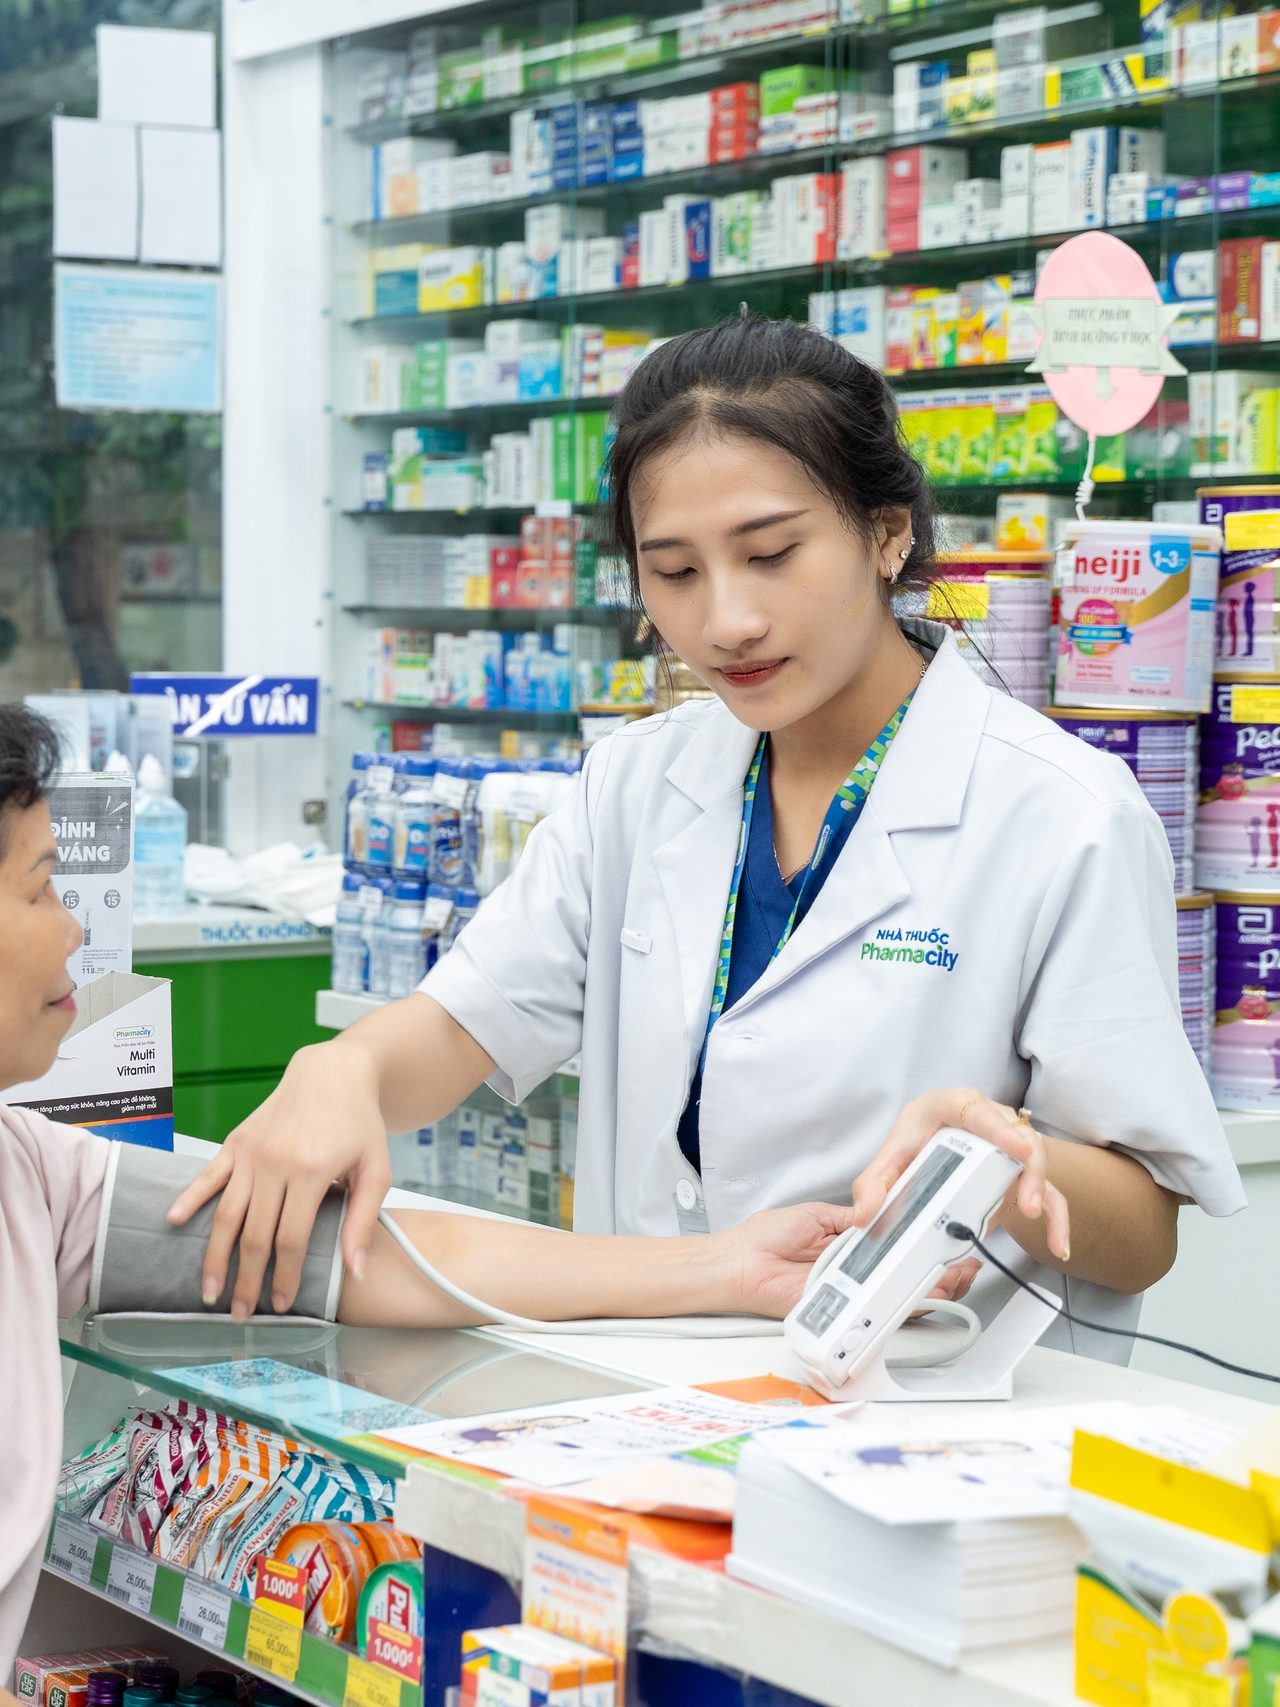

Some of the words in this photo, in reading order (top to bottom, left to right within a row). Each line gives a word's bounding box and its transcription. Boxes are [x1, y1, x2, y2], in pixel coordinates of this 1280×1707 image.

[249, 682, 309, 726] VẤN
[876, 928, 903, 941] NHÀ
[905, 927, 950, 945] THUỐC
[860, 942, 959, 972] Pharmacity
[116, 1027, 152, 1038] Pharmacity
[129, 1048, 156, 1062] Multi
[117, 1063, 156, 1077] Vitamin
[234, 1511, 272, 1559] SPEARMINT
[23, 1674, 35, 1686] tic
[21, 1683, 34, 1695] tac
[53, 1688, 65, 1700] tic
